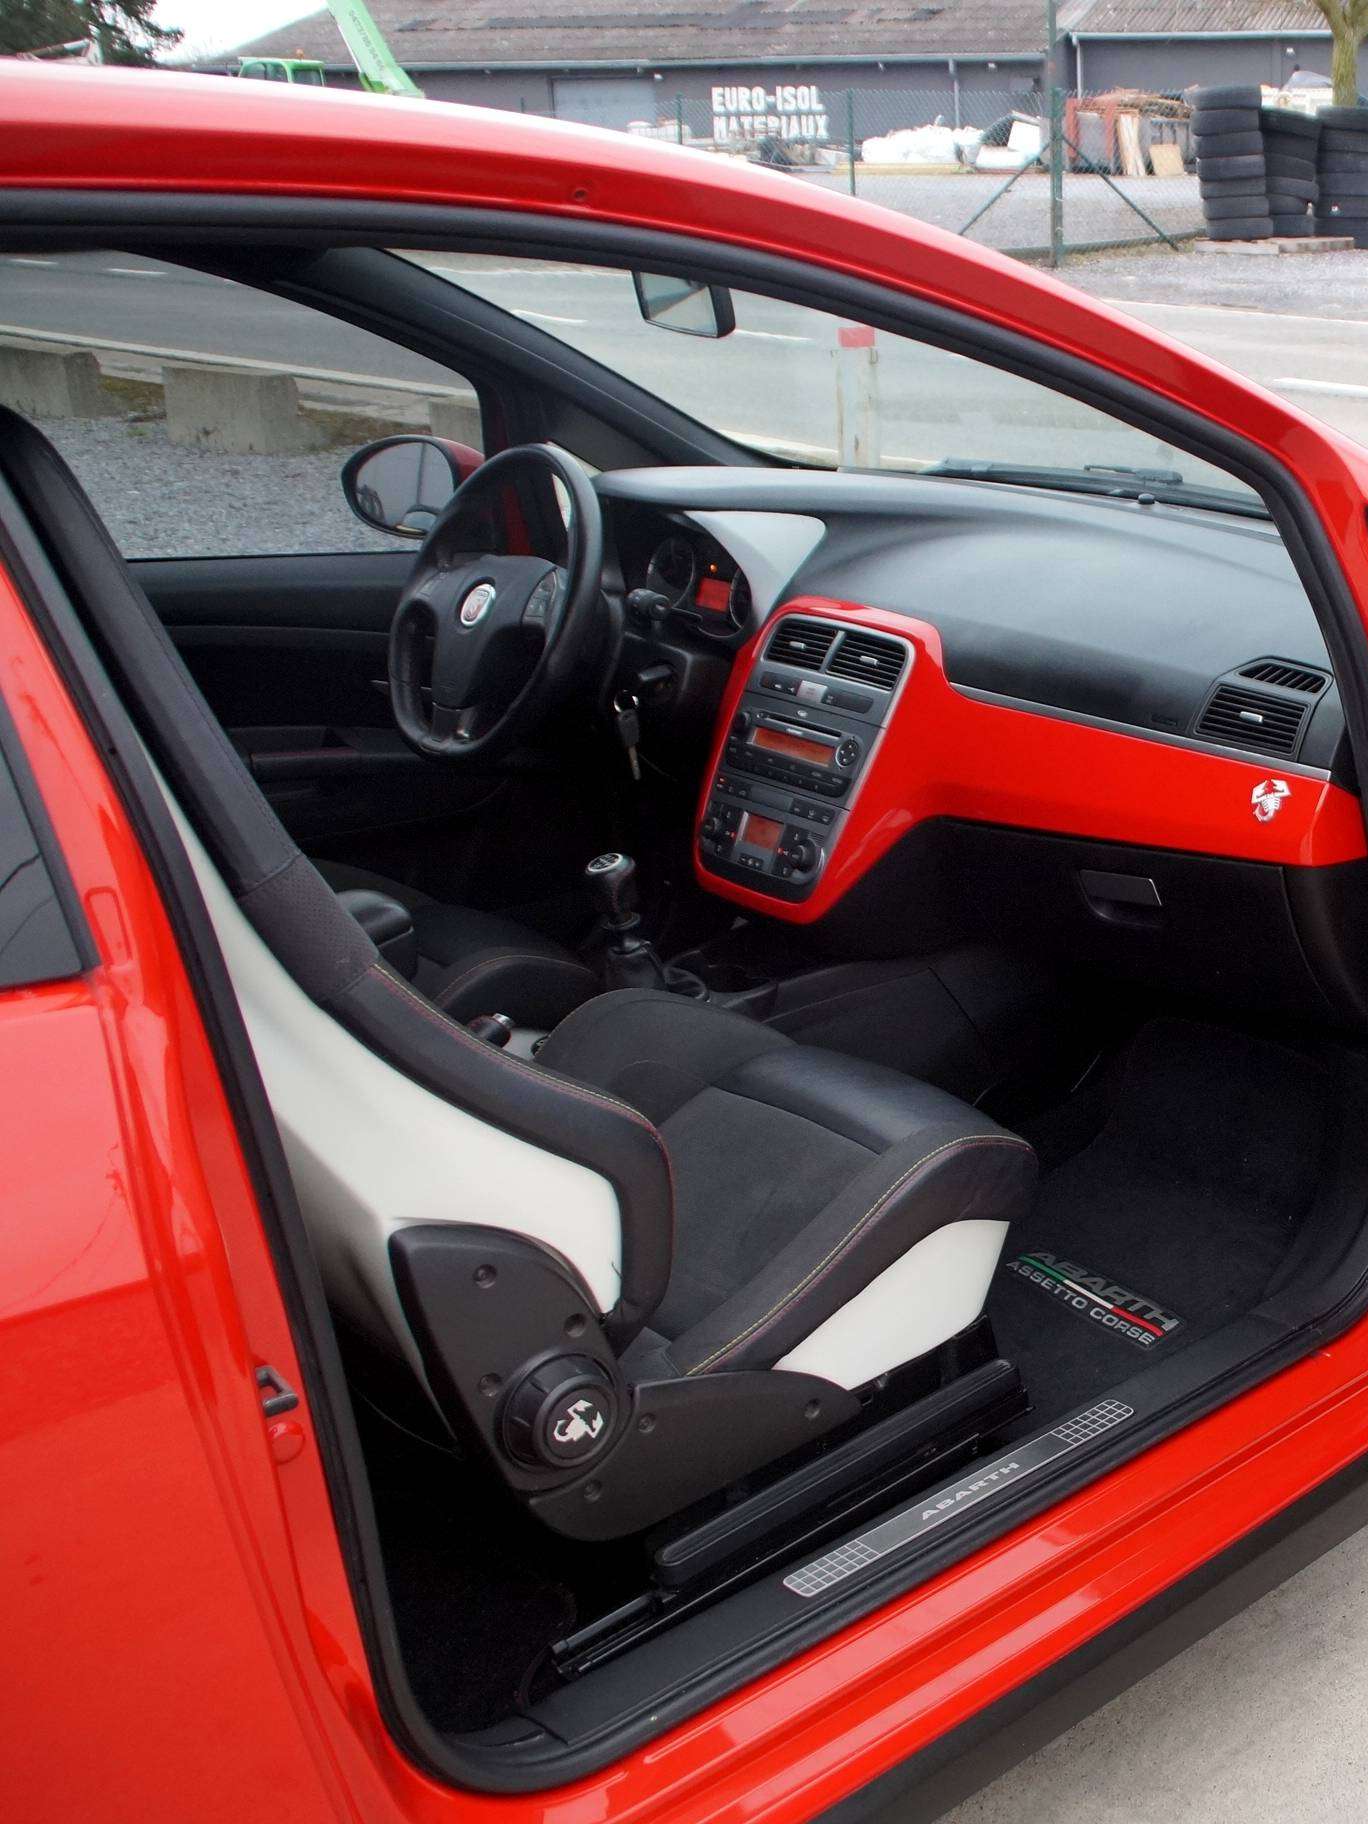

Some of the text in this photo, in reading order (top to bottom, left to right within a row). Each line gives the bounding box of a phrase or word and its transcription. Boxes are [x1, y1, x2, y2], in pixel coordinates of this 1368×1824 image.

[711, 85, 825, 112] EURO-ISOL
[1006, 1260, 1156, 1346] ASSETTO CORSE
[1028, 1251, 1180, 1331] ABARTH
[921, 1461, 1019, 1521] ABARTH
